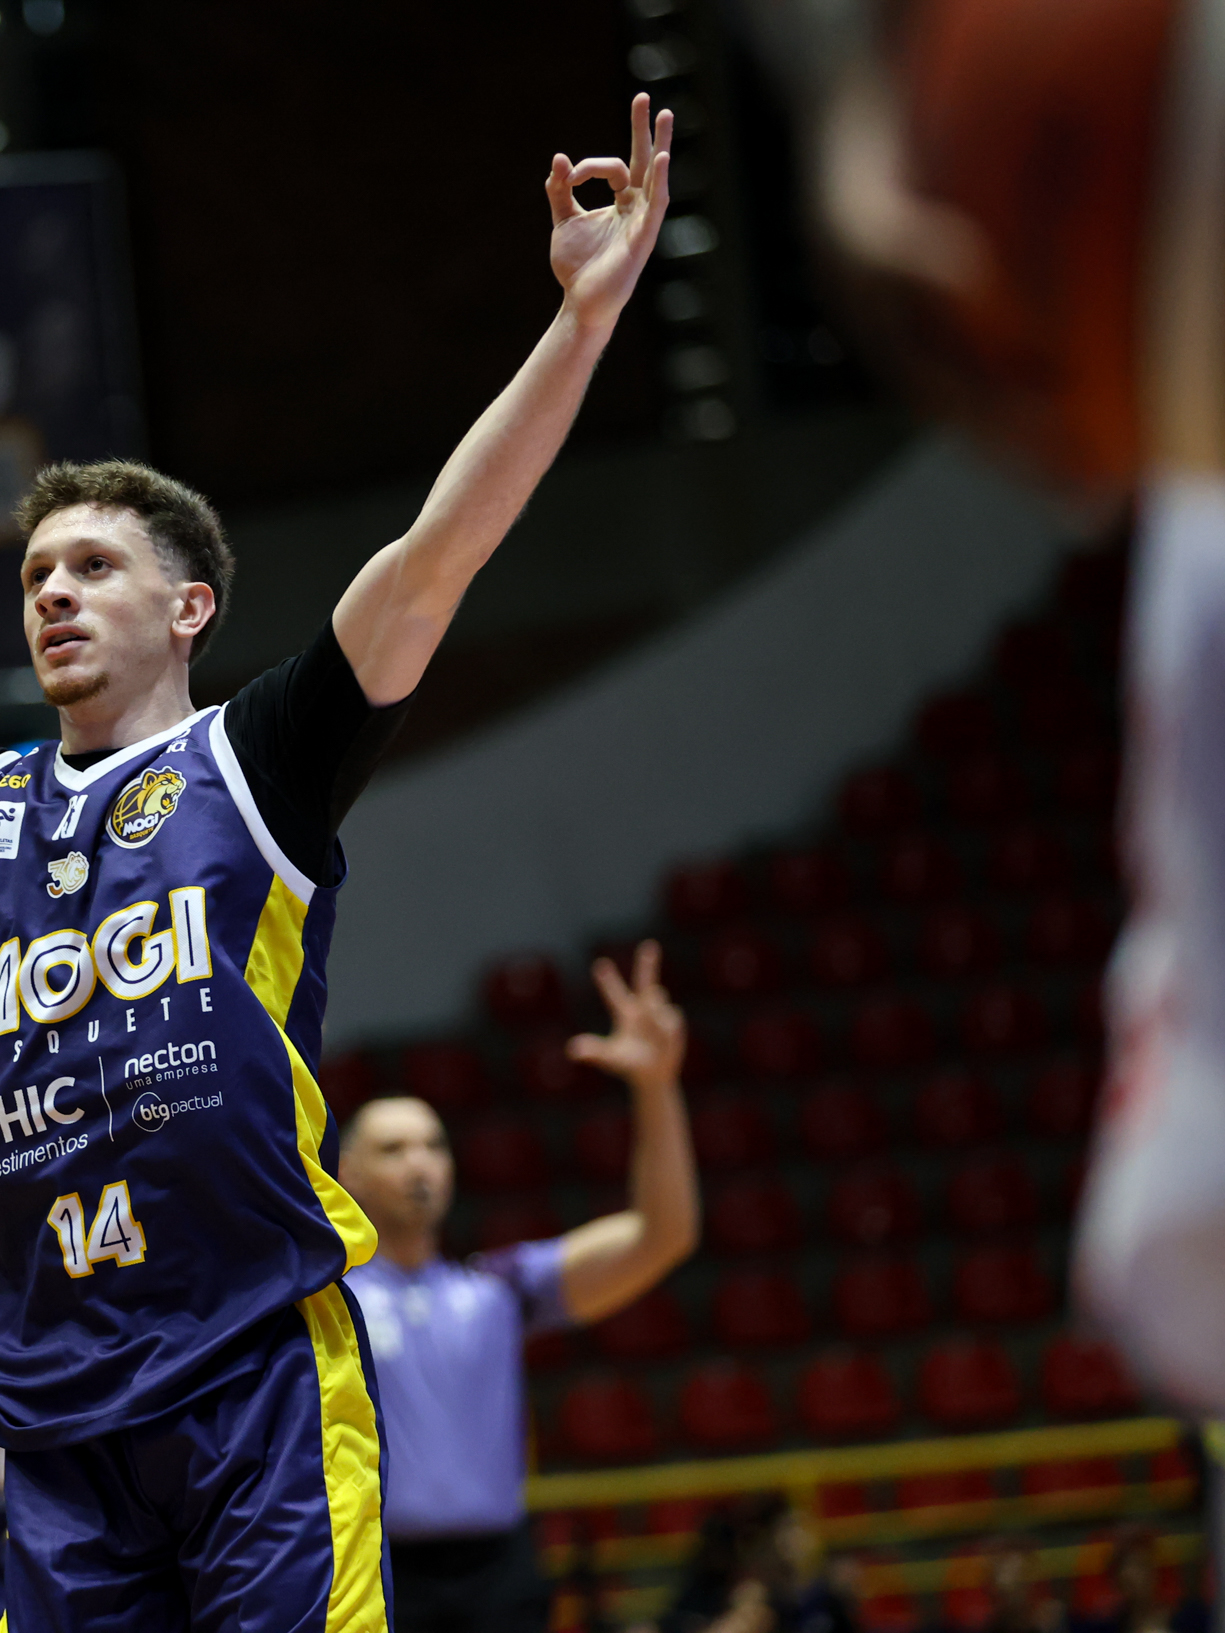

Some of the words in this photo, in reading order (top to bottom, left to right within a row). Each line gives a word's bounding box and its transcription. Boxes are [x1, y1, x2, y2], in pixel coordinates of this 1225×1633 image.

[122, 812, 159, 837] MOGI
[124, 1040, 217, 1079] necton
[125, 1076, 153, 1091] uma
[155, 1062, 219, 1083] empresa
[46, 1179, 148, 1279] 14
